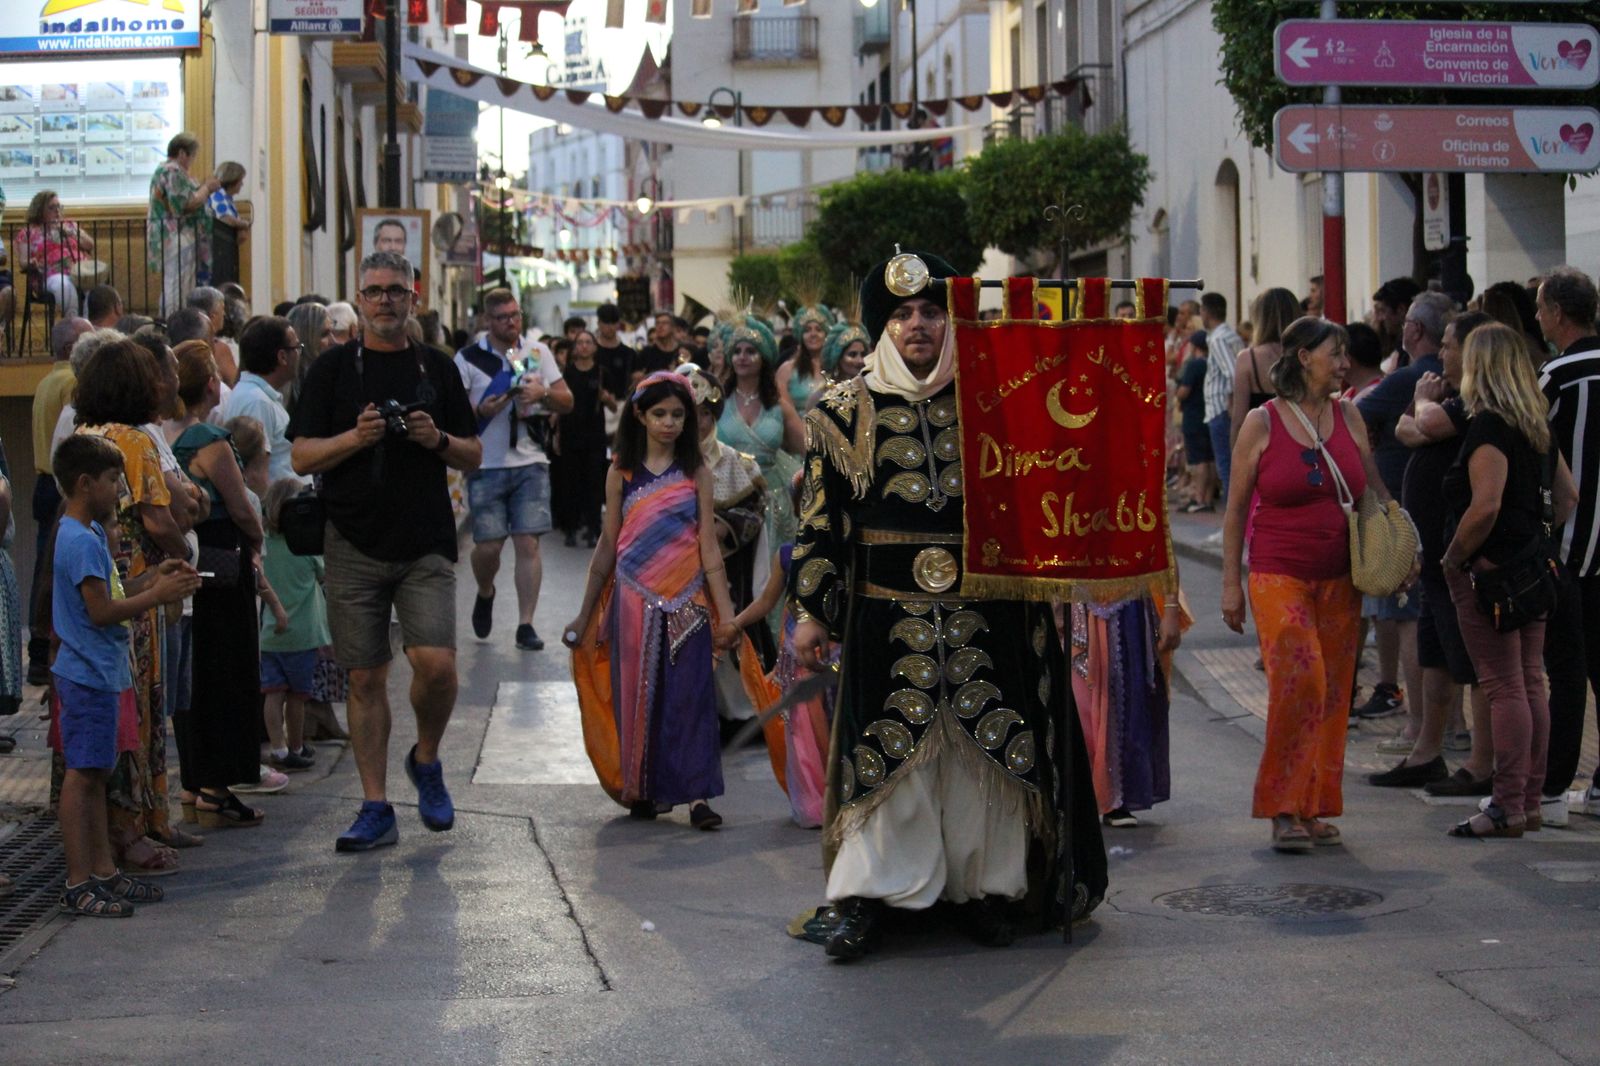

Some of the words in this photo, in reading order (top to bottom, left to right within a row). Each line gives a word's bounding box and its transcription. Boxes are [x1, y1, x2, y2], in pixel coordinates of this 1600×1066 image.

[294, 6, 338, 16] SEGUROS
[39, 17, 185, 34] indalhome
[290, 20, 327, 32] Allianz
[1430, 28, 1472, 41] Iglesia
[1476, 28, 1493, 40] de
[1496, 28, 1508, 40] la
[37, 35, 174, 50] www.indalhome.com
[1336, 40, 1345, 53] 2
[1425, 40, 1509, 53] Encarnación
[1424, 58, 1489, 70] Convento
[1492, 59, 1509, 70] de
[1443, 71, 1455, 83] la
[1459, 71, 1509, 83] Victoria
[1456, 114, 1509, 127] Correos
[1442, 139, 1489, 152] Oficina
[1492, 140, 1510, 153] de
[1456, 154, 1510, 167] Turismo
